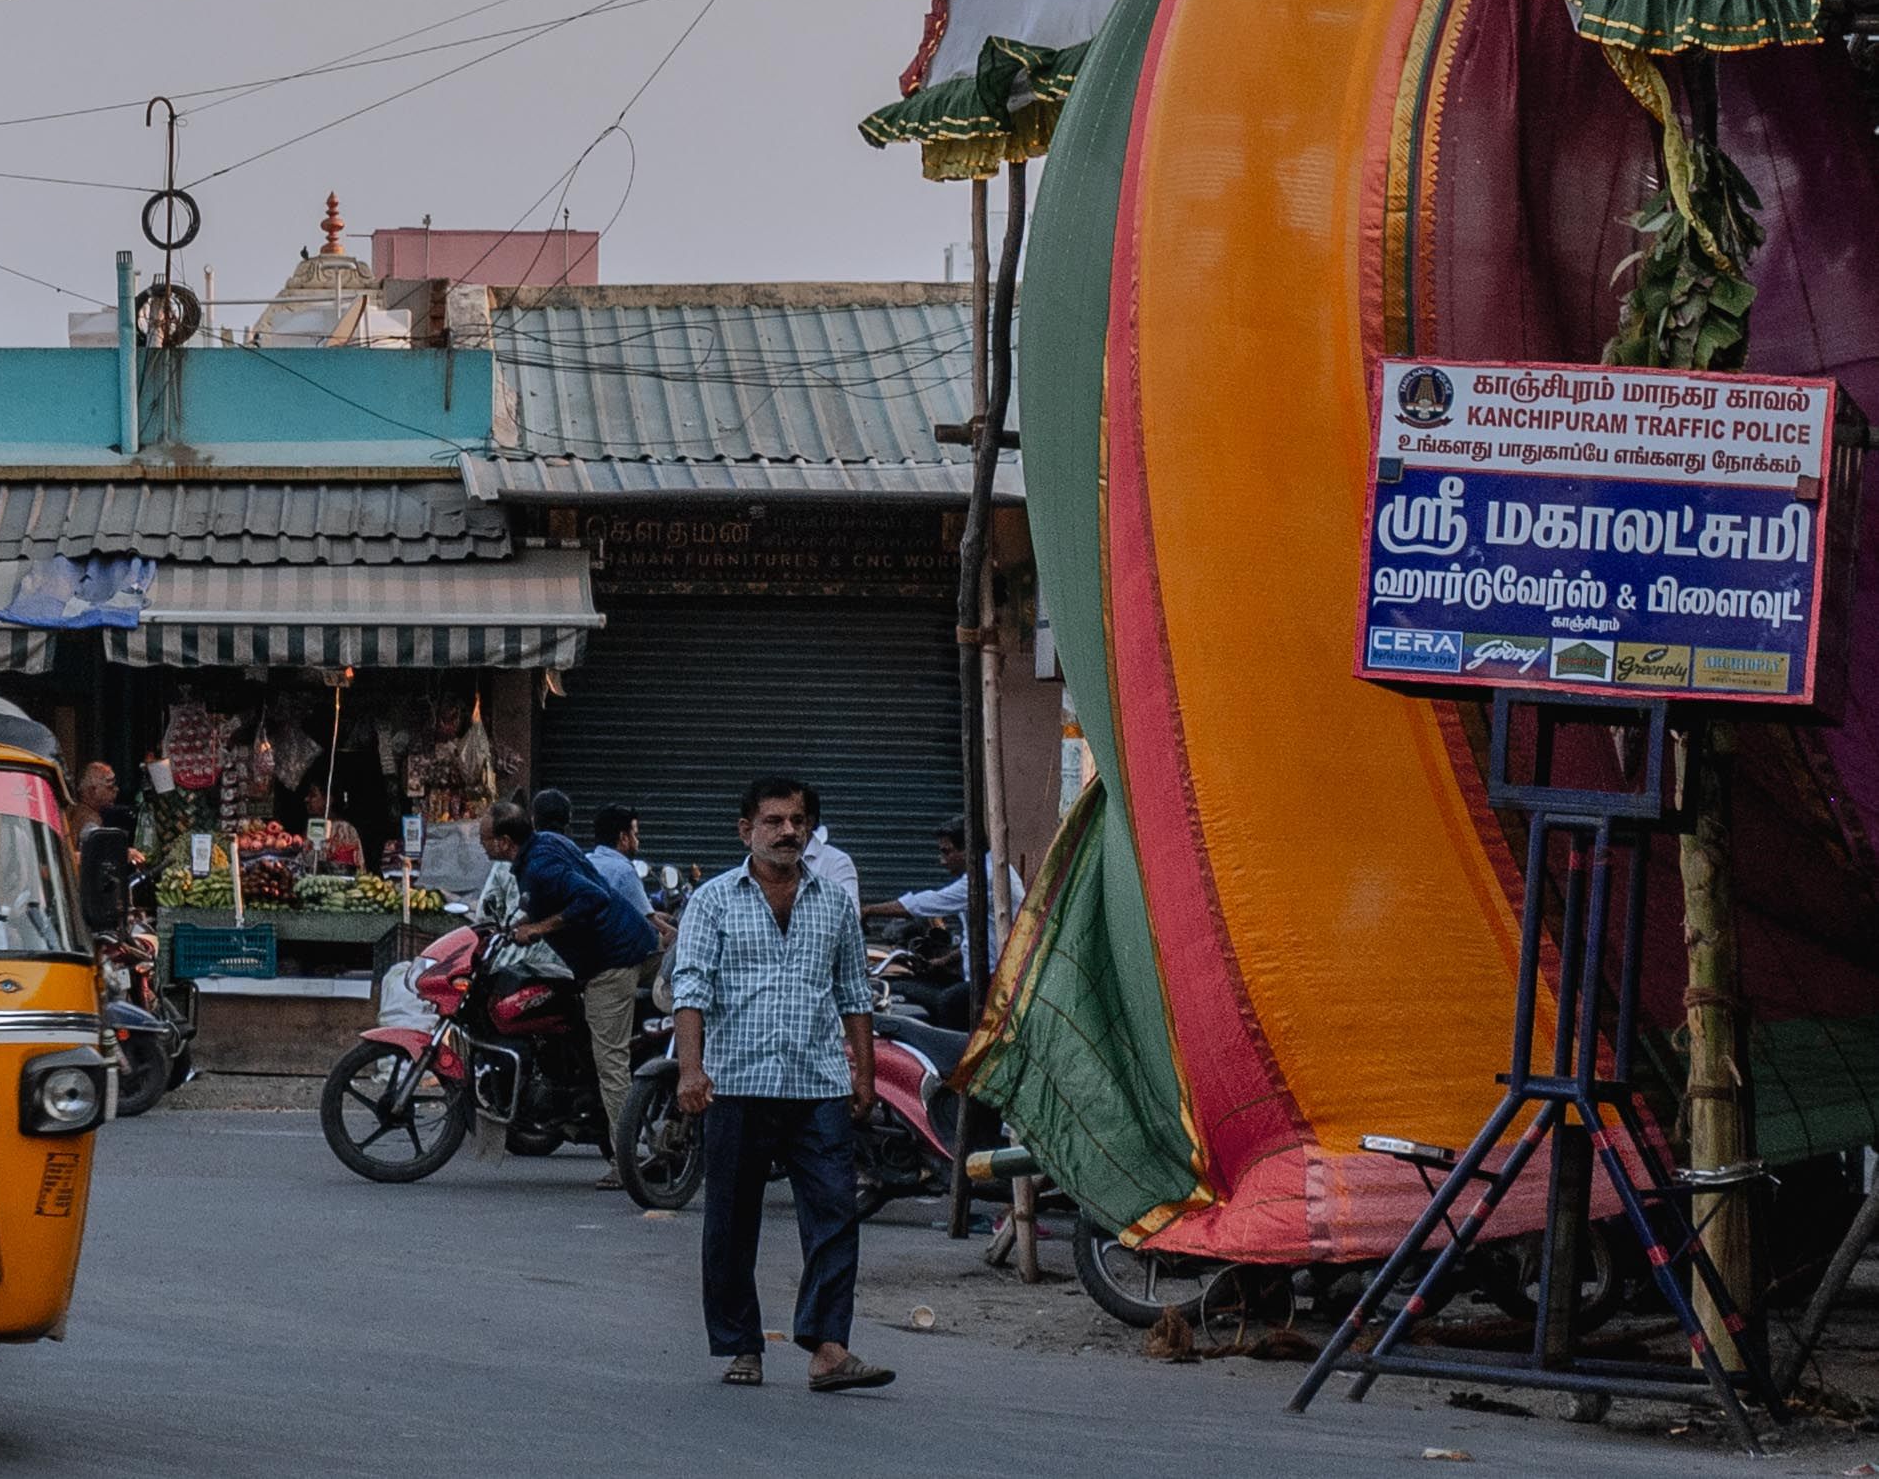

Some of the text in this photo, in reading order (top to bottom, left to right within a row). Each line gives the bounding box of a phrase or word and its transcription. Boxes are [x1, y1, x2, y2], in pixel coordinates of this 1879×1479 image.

[1472, 371, 1811, 413] காஞ்சிபுரம் மாநகர காவல்
[1467, 405, 1630, 435] KANCHIPURAM
[1634, 414, 1726, 440] TRAFFIC
[1732, 419, 1811, 445] POLICE
[1398, 432, 1803, 476] உங்களது பாதுகாப்பே எங்களது நோக்கம்
[1377, 475, 1811, 562] ஸ்ரீ மகாலட்சுமி
[683, 553, 821, 567] FURNITURES
[852, 554, 893, 568] CNC
[1372, 562, 1804, 628] ஹார்டுவேர்ஸ் & பிளைவுட்
[1373, 630, 1457, 654] CERA
[1551, 614, 1620, 634] காஞ்சிபுரம்
[1465, 639, 1545, 674] Godrej
[1618, 655, 1688, 682] Greenply
